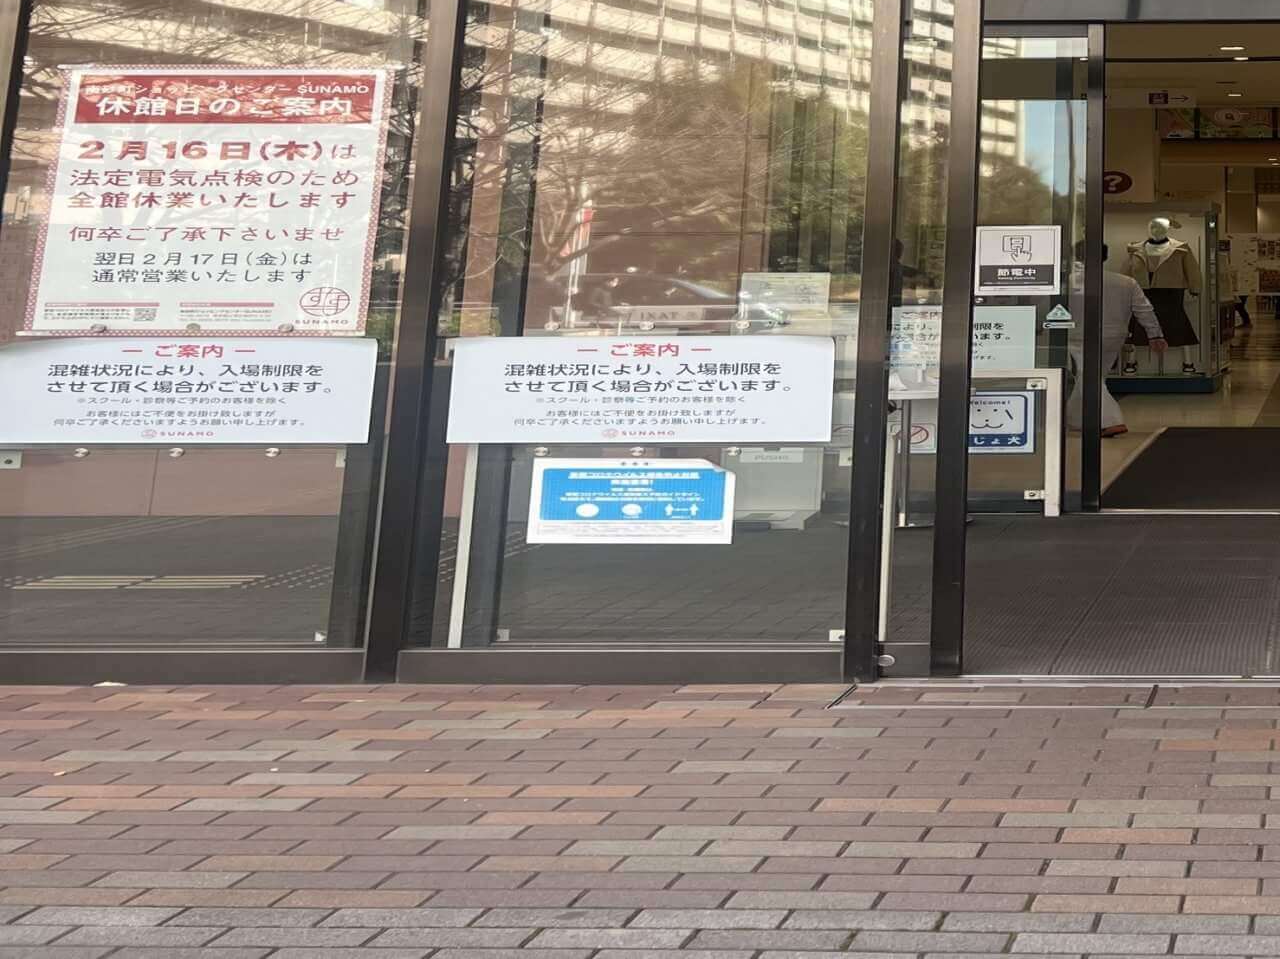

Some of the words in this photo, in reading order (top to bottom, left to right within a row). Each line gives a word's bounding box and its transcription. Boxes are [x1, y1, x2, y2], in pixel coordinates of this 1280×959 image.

[297, 85, 369, 95] SUNAMO
[97, 96, 353, 117] 休館日のご案内
[69, 168, 359, 187] 法定電気点検のため
[66, 191, 357, 209] 全館休業いたします
[69, 226, 346, 242] 何卒ご了承下さいませ
[92, 268, 312, 283] 通常営業いたします
[48, 364, 325, 378] 混雑状況により、入場制限を
[504, 363, 782, 376] 混雑状況により、入場制限を
[47, 380, 333, 394] させて頂く場合がございます。
[504, 379, 792, 393] させて頂く場合がございます。
